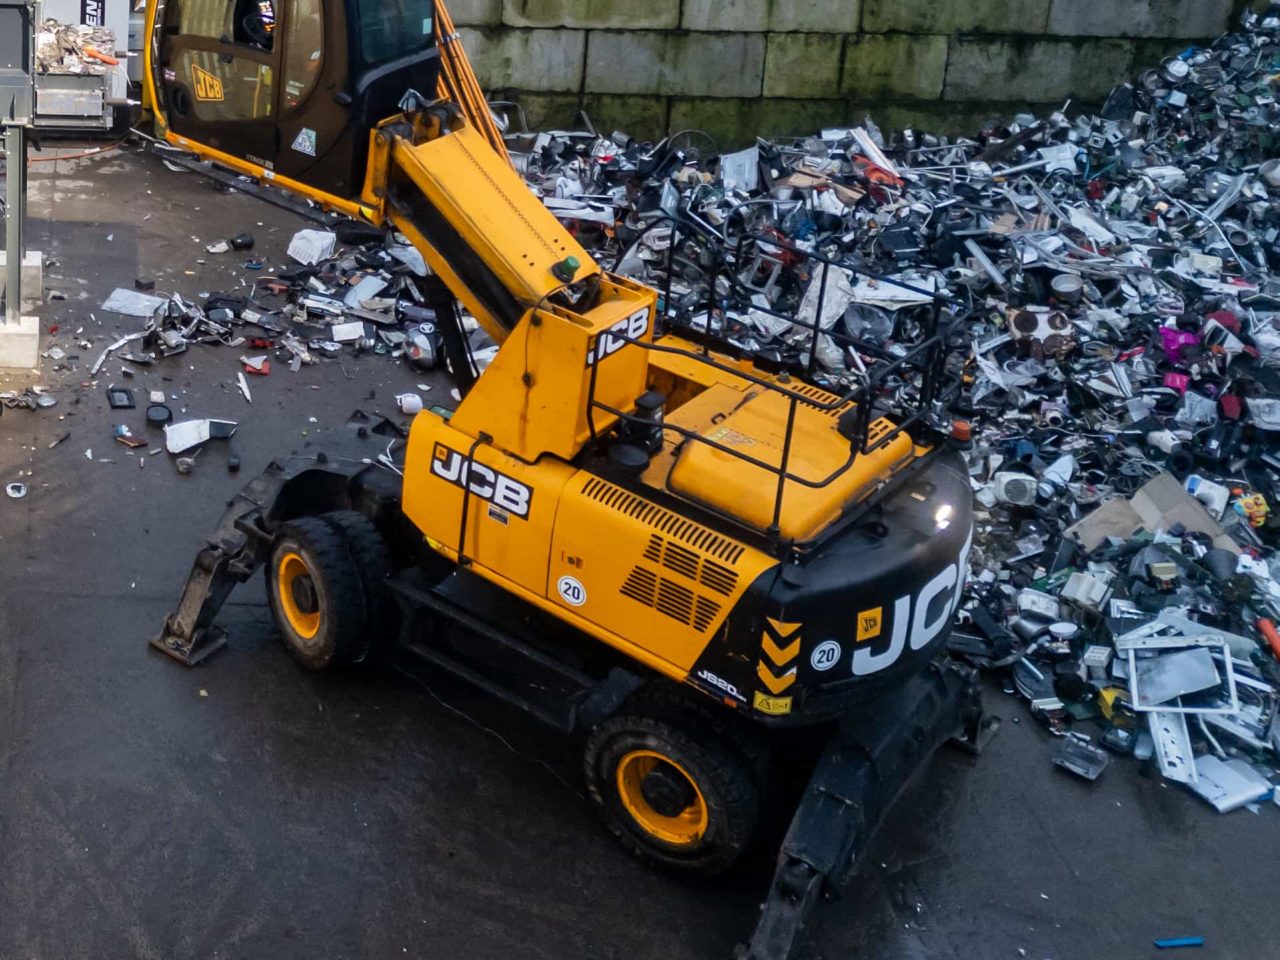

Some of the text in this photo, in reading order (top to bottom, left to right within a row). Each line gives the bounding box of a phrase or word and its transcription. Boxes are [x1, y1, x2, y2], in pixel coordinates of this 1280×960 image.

[195, 69, 223, 99] JCB
[588, 307, 650, 365] JCB
[433, 452, 531, 516] JCB
[563, 581, 581, 600] 20
[816, 647, 835, 664] 20
